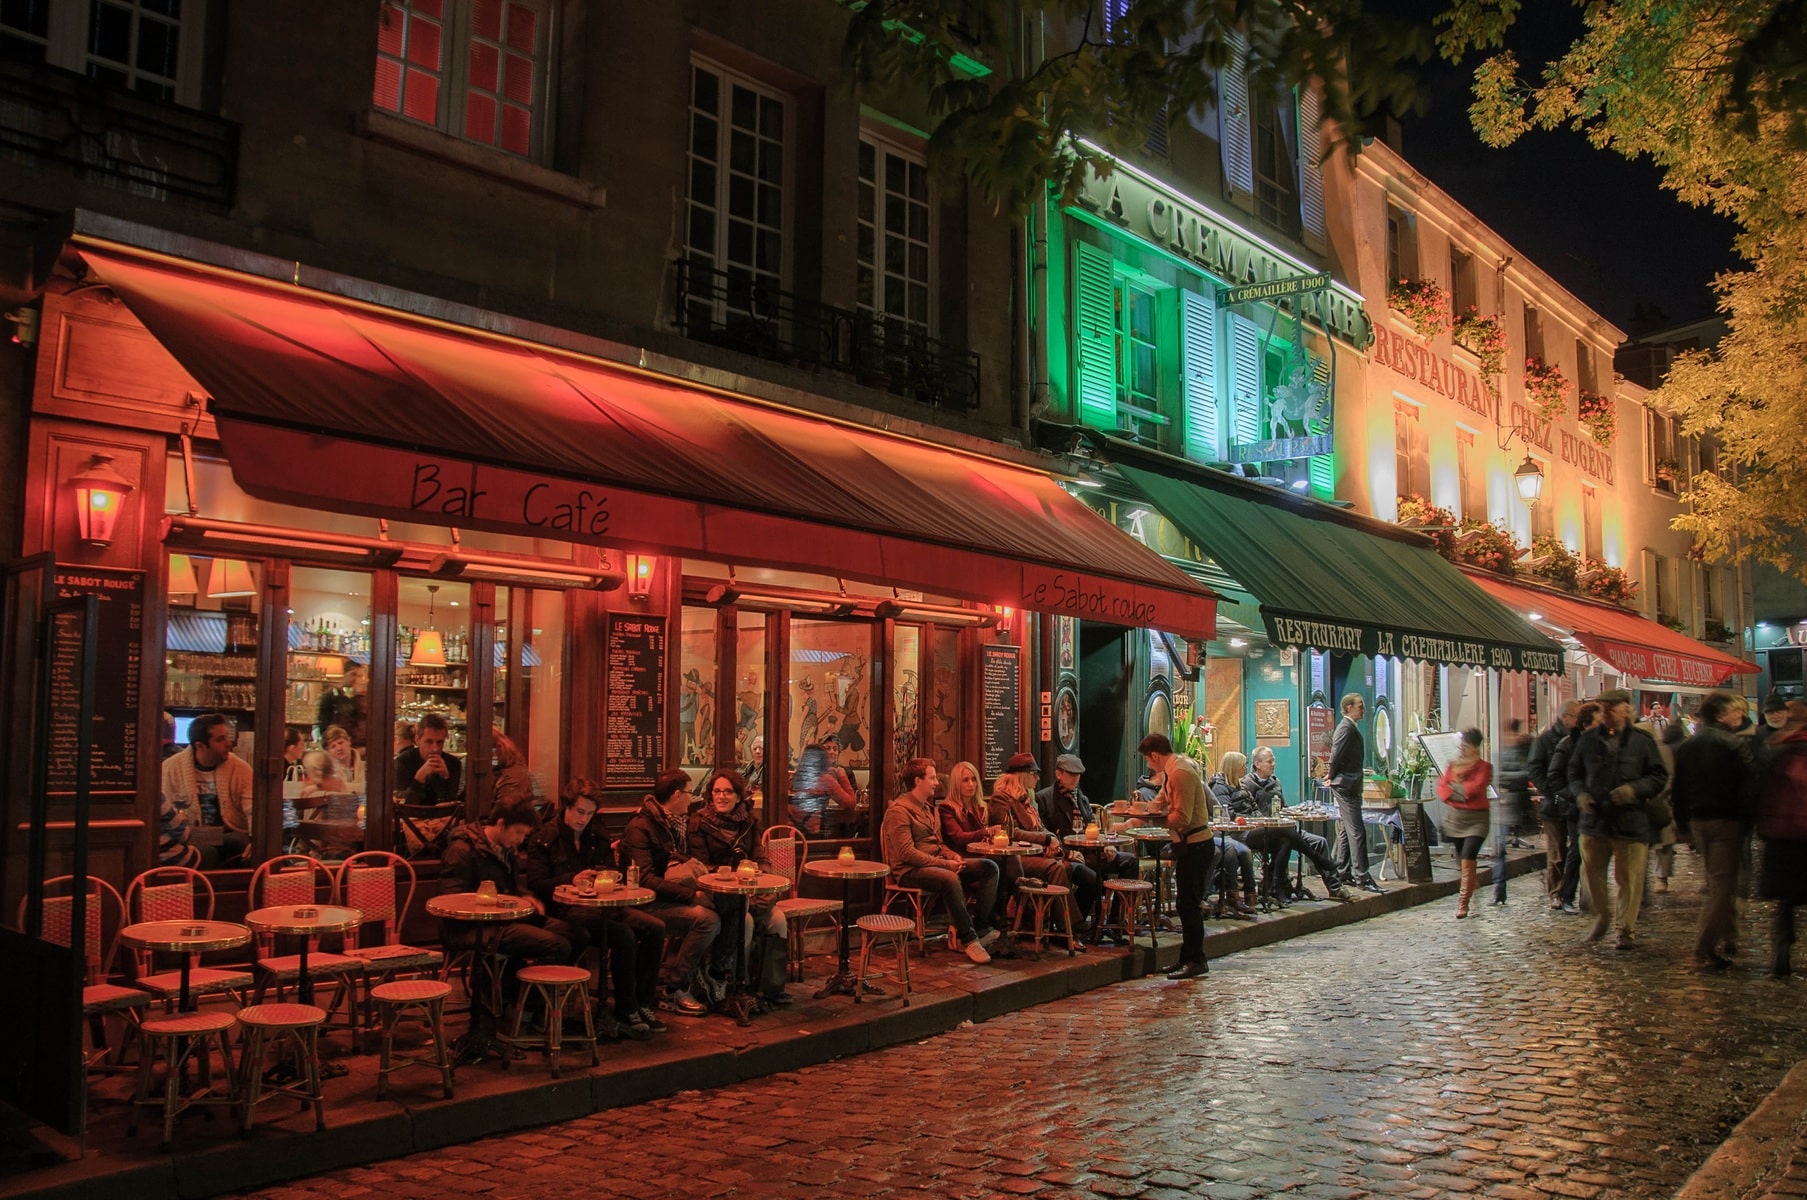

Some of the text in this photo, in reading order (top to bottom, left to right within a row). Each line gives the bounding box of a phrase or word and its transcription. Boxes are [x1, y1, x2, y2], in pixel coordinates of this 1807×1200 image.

[1222, 276, 1325, 303] LA CRÉMAILLÈRE 1900
[1510, 401, 1553, 454] CHEZ
[411, 463, 610, 536] Bar Café
[67, 575, 101, 587] SABOT
[103, 579, 135, 590] ROUGE
[1020, 566, 1156, 626] Le Sabot rouge
[614, 621, 623, 631] LE
[1274, 617, 1560, 672] RESTAURANT LA CREMAILLERE 1900 CABARET
[1653, 653, 1679, 678] CHEZ
